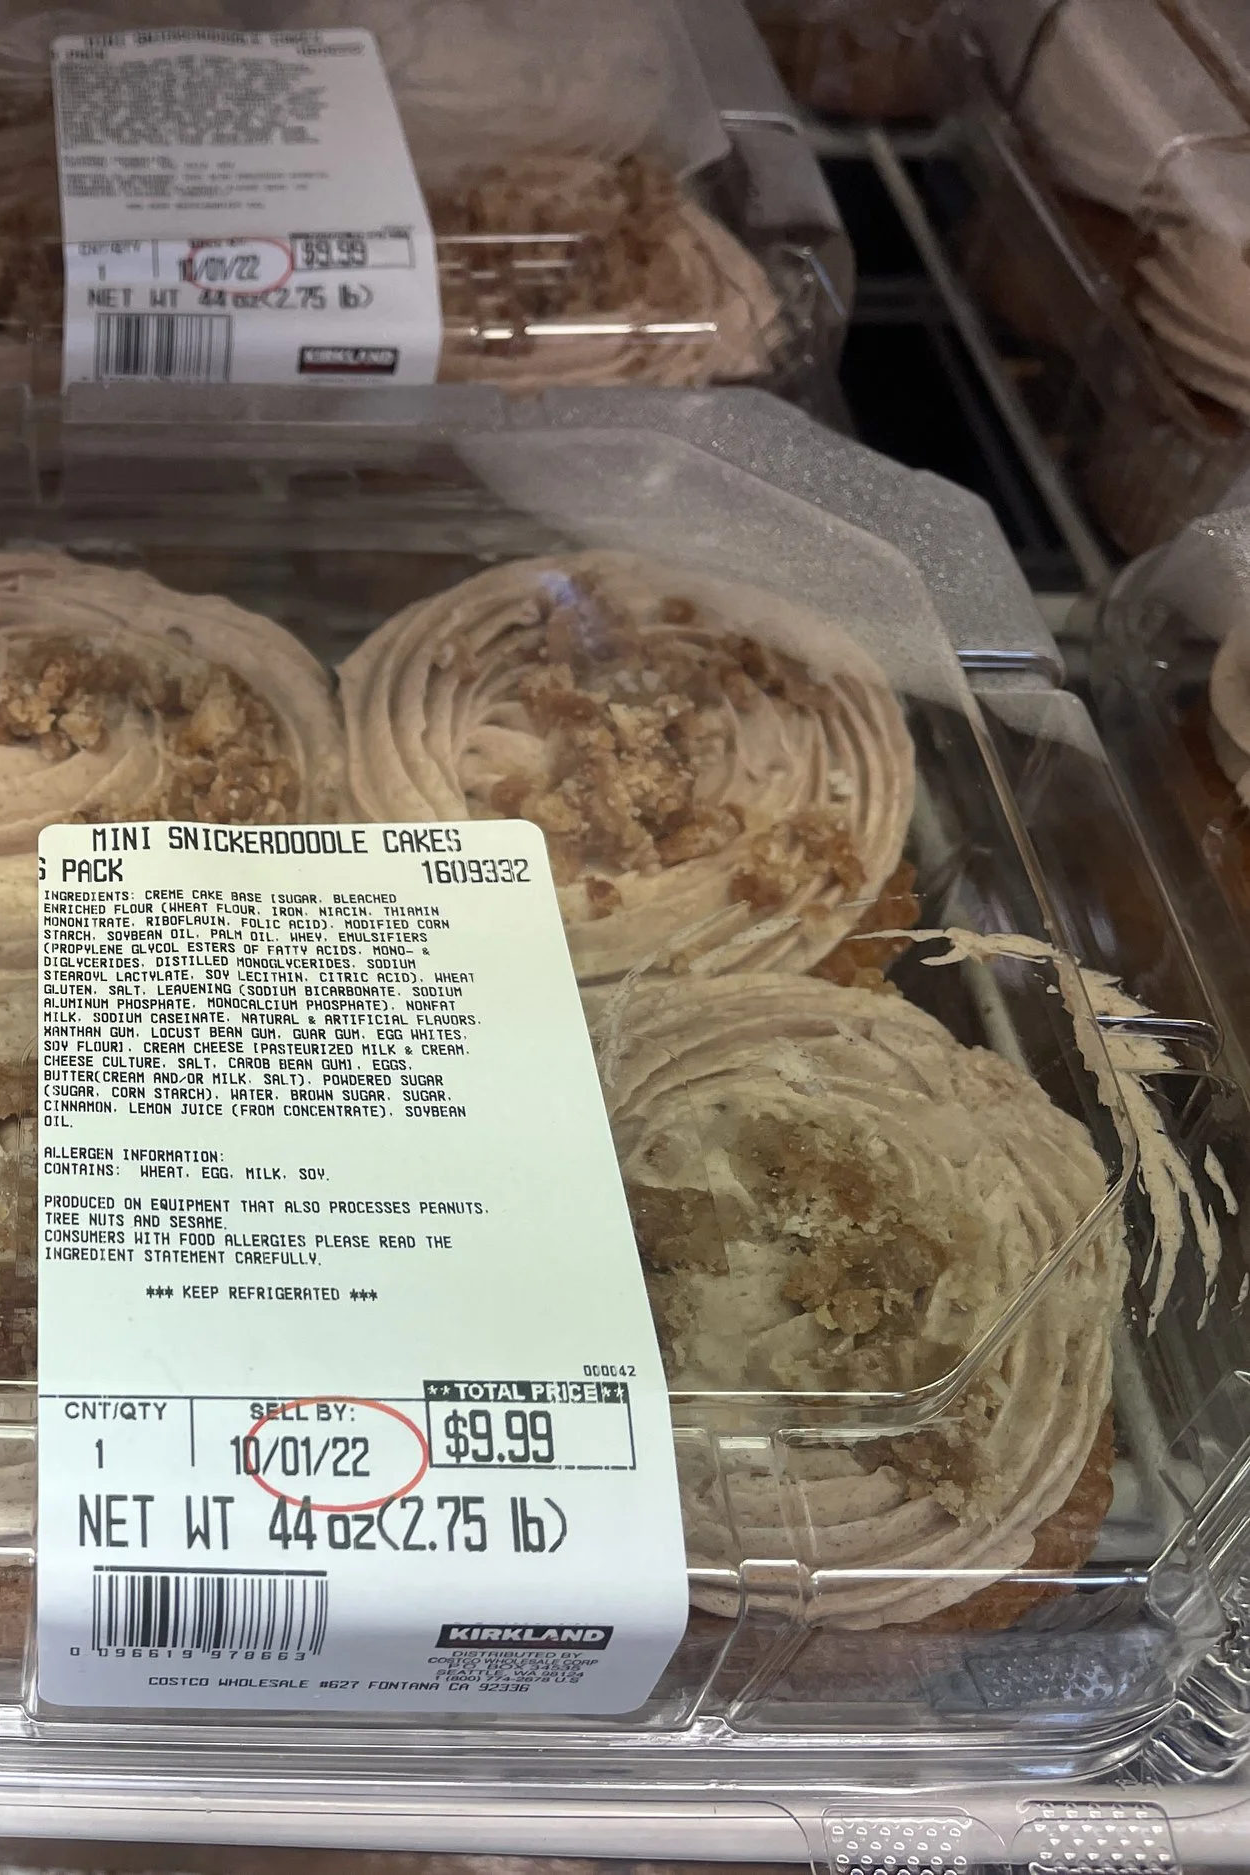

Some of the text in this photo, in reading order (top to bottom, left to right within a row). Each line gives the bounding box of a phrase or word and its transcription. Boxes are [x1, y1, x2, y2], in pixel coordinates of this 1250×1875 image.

[87, 287, 132, 308] NET
[92, 826, 462, 855] MINI SNICKERDOODLE CAKES
[62, 857, 124, 883] PACK
[421, 858, 532, 884] 1609332
[44, 888, 397, 904] INGREDIENTS: CREME CAKE BASE BLEACHED
[43, 901, 440, 917] ENRICHED FLOUR (WHEAT THIAMIN
[240, 916, 281, 930] FOLIC
[343, 919, 410, 930] MODIFIED
[416, 919, 450, 930] CORN
[106, 928, 428, 943] SOYBEAN PALM EMULSIFIERS
[43, 941, 124, 955] (PROPYLENE
[131, 941, 180, 955] GLYCOL
[186, 941, 236, 954] ESTERS
[243, 943, 259, 955] OF
[266, 944, 308, 956] FATTY
[421, 946, 431, 956] &
[155, 954, 229, 968] DISTILLED
[366, 958, 417, 970] SODIUM
[43, 968, 474, 984] STEAROYL SOY CITRIC WHEAT
[157, 982, 232, 996] LEAVENING
[238, 983, 297, 997] (SODIUM
[411, 986, 463, 998] SODIUM
[43, 996, 456, 1012] ALUMINUM MONOCALCIUM NONFAT
[92, 1011, 143, 1024] SODIUM
[241, 1012, 300, 1025] NATURAL
[307, 1015, 317, 1025] &
[324, 1013, 409, 1026] ARTIFICIAL
[43, 1025, 404, 1041] XANTHAN LOCUST BEAN GUAR EGG
[43, 1039, 414, 1056] SOY CREAM CHEESE [PASTEURIZED MILK &
[43, 1054, 94, 1068] CHEESE
[228, 1056, 271, 1070] CAROB
[278, 1058, 314, 1071] BEAN
[322, 1073, 392, 1087] POWDERED
[400, 1074, 444, 1087] SUGAR
[111, 1086, 146, 1099] CORN
[290, 1088, 334, 1102] BROWN
[128, 1101, 172, 1115] LEMON
[180, 1102, 223, 1116] JUICE
[231, 1103, 275, 1118] (FROM
[404, 1105, 467, 1118] SOYBEAN
[43, 1114, 74, 1129] OIL.
[43, 1146, 224, 1164] ALLERGEN INFORMATION:
[43, 1161, 330, 1182] CONTAINS: SOY.
[44, 1194, 115, 1210] PRODUCED
[123, 1197, 142, 1211] ON
[150, 1197, 231, 1213] EQUIPMENT
[240, 1199, 275, 1214] THAT
[284, 1200, 321, 1214] ALSO
[328, 1200, 411, 1215] PROCESSES
[45, 1211, 228, 1231] TREE NUTS AND SESAME.
[44, 1228, 453, 1249] CONSUMERS WITH FOOD ALLERGIES PLEASE READ THE
[45, 1246, 322, 1267] INGREDIENT STATEMENT CAREFULLY.
[182, 1284, 340, 1301] KEEP REFRIGERATED
[582, 1364, 637, 1378] 000042
[454, 1382, 598, 1404] TOTAL PRICE
[64, 1401, 168, 1420] CNT/QTY
[249, 1401, 356, 1423] SELL BY:
[444, 1409, 555, 1464] $9.99
[95, 1438, 104, 1469] 1
[230, 1435, 370, 1477] 10/01/22
[79, 1494, 155, 1549] NET
[185, 1495, 235, 1551] WT
[268, 1494, 318, 1550] 44
[510, 1496, 568, 1553] lb)
[448, 1627, 606, 1643] KIRKLAND
[452, 1650, 557, 1659] DISTRIBUTED
[484, 1658, 561, 1666] WHOLESALE
[148, 1676, 531, 1693] COSTCO WHOLESALE #627 FONTANA CA 92336
